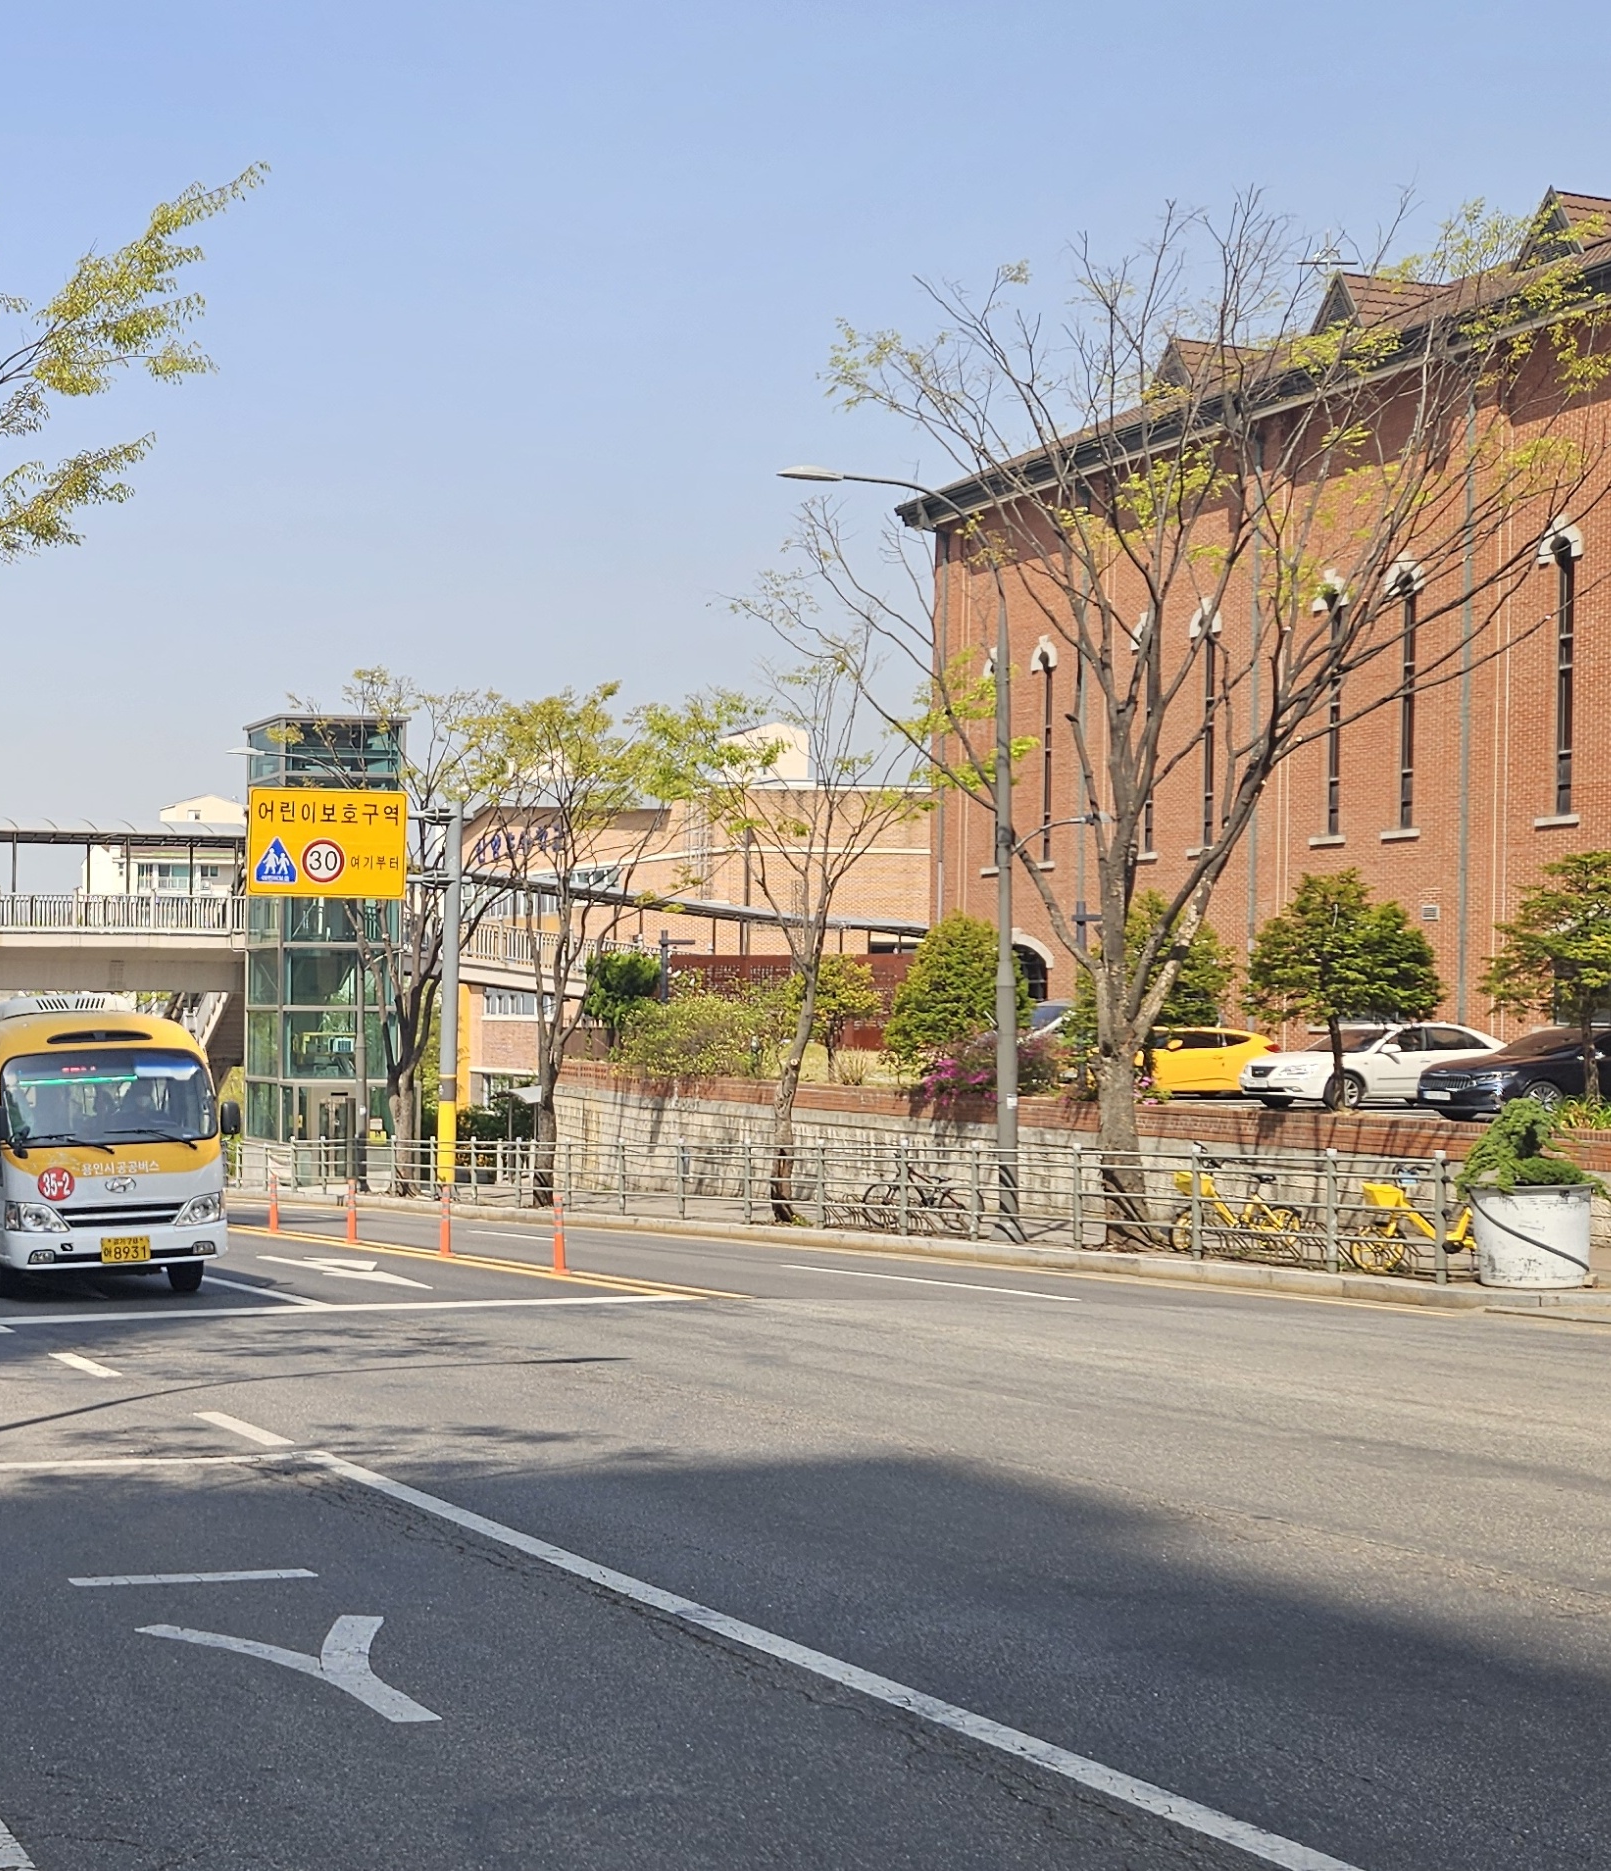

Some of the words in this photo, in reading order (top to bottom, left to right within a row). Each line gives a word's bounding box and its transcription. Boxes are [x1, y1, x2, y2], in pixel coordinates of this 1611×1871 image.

[258, 800, 399, 826] 어린이보호구역
[309, 850, 338, 871] 30
[350, 856, 399, 870] 여기부터
[43, 1172, 71, 1197] 35-2
